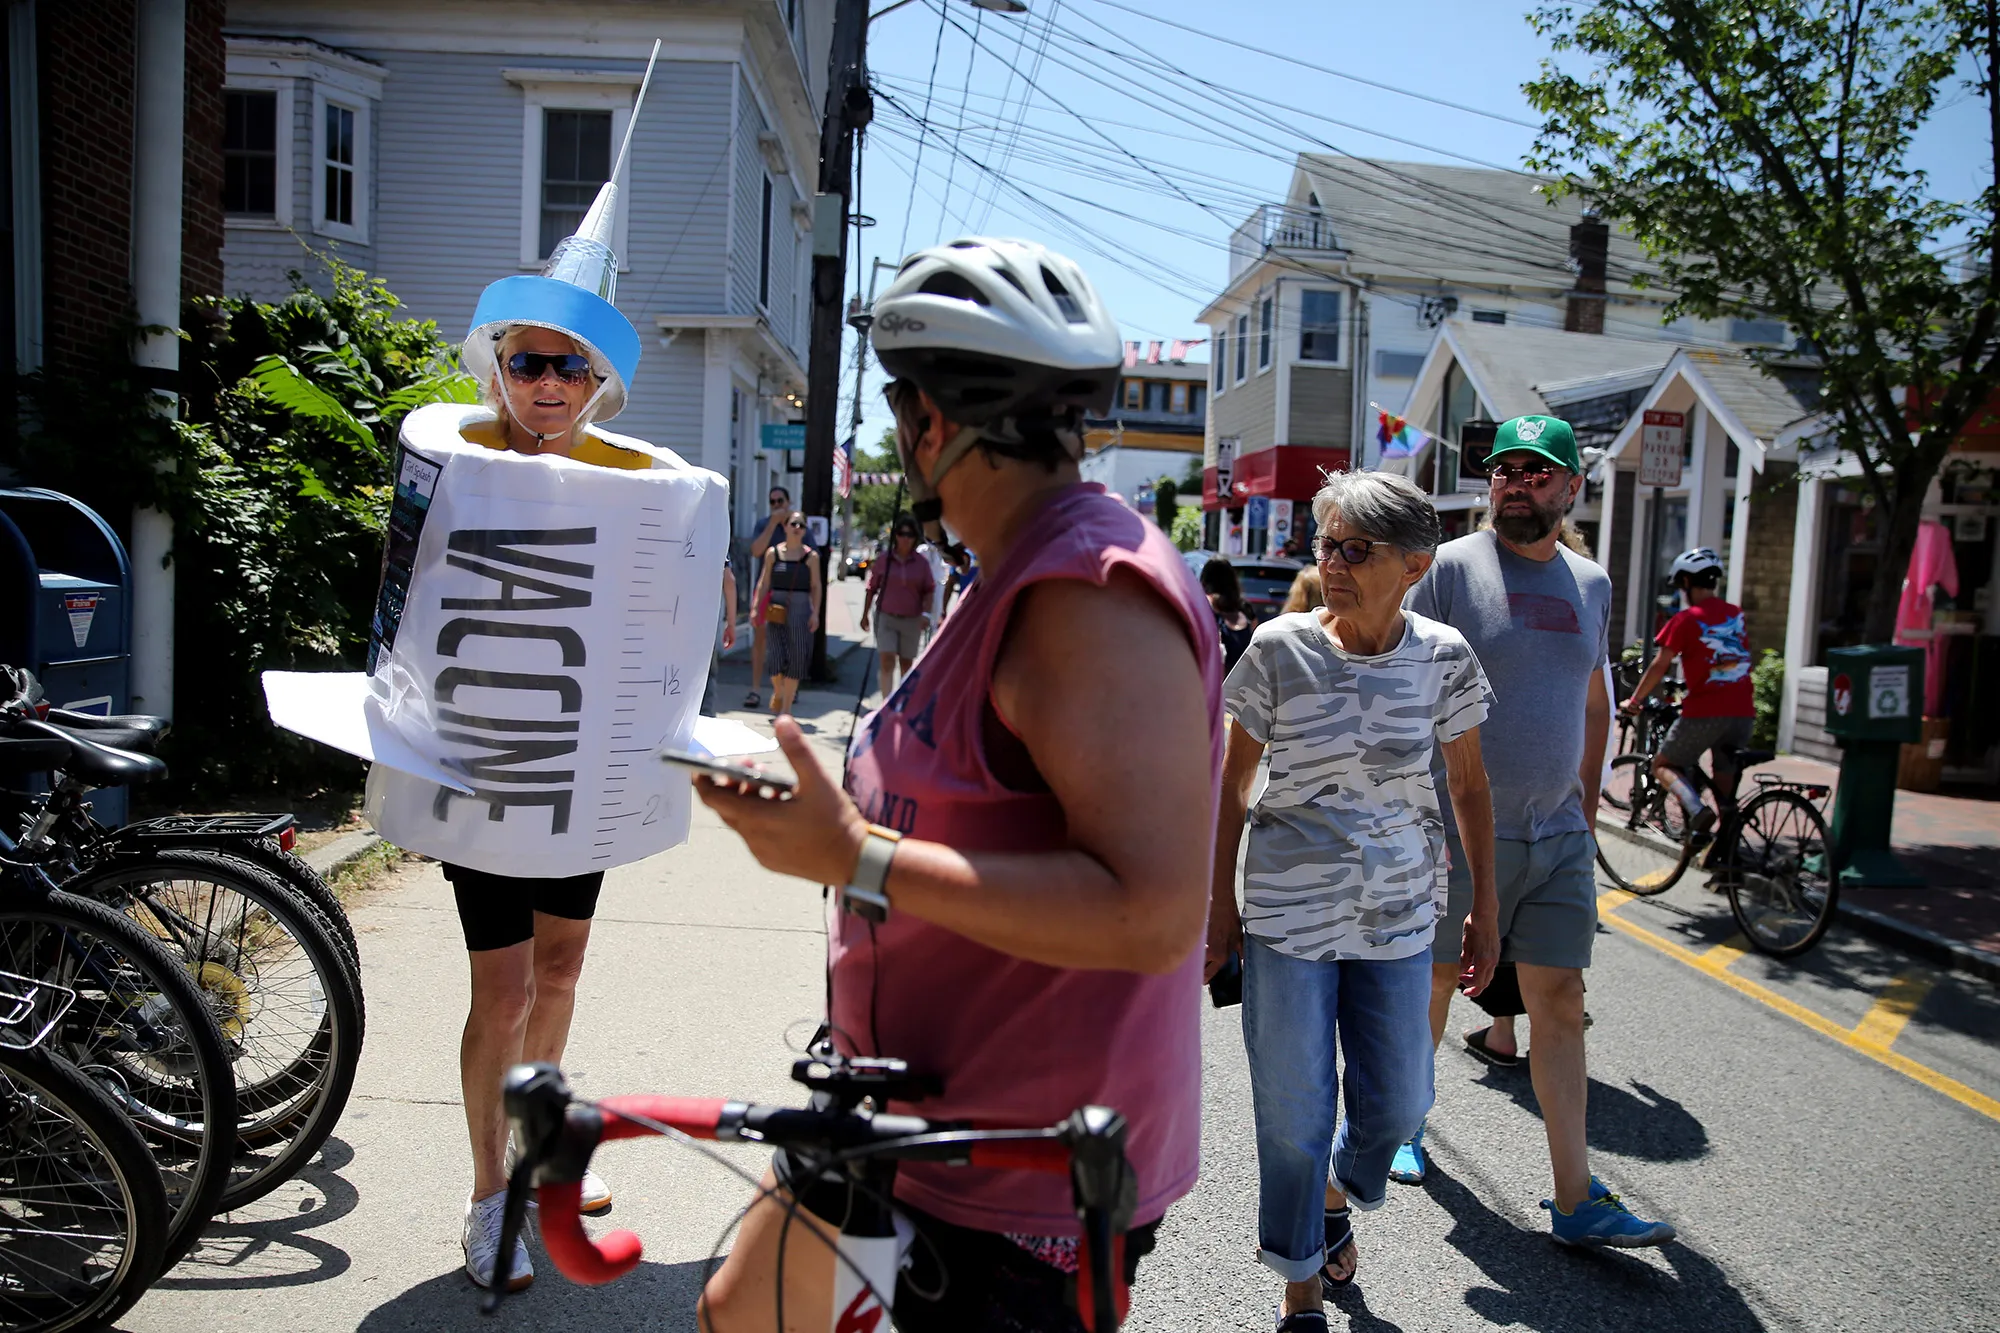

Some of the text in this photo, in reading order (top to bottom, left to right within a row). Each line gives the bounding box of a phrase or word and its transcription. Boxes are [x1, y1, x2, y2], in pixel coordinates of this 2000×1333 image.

[879, 311, 926, 338] Giro
[1656, 430, 1670, 441] NO
[404, 460, 432, 482] Girl Splash
[433, 527, 597, 835] VACCINE
